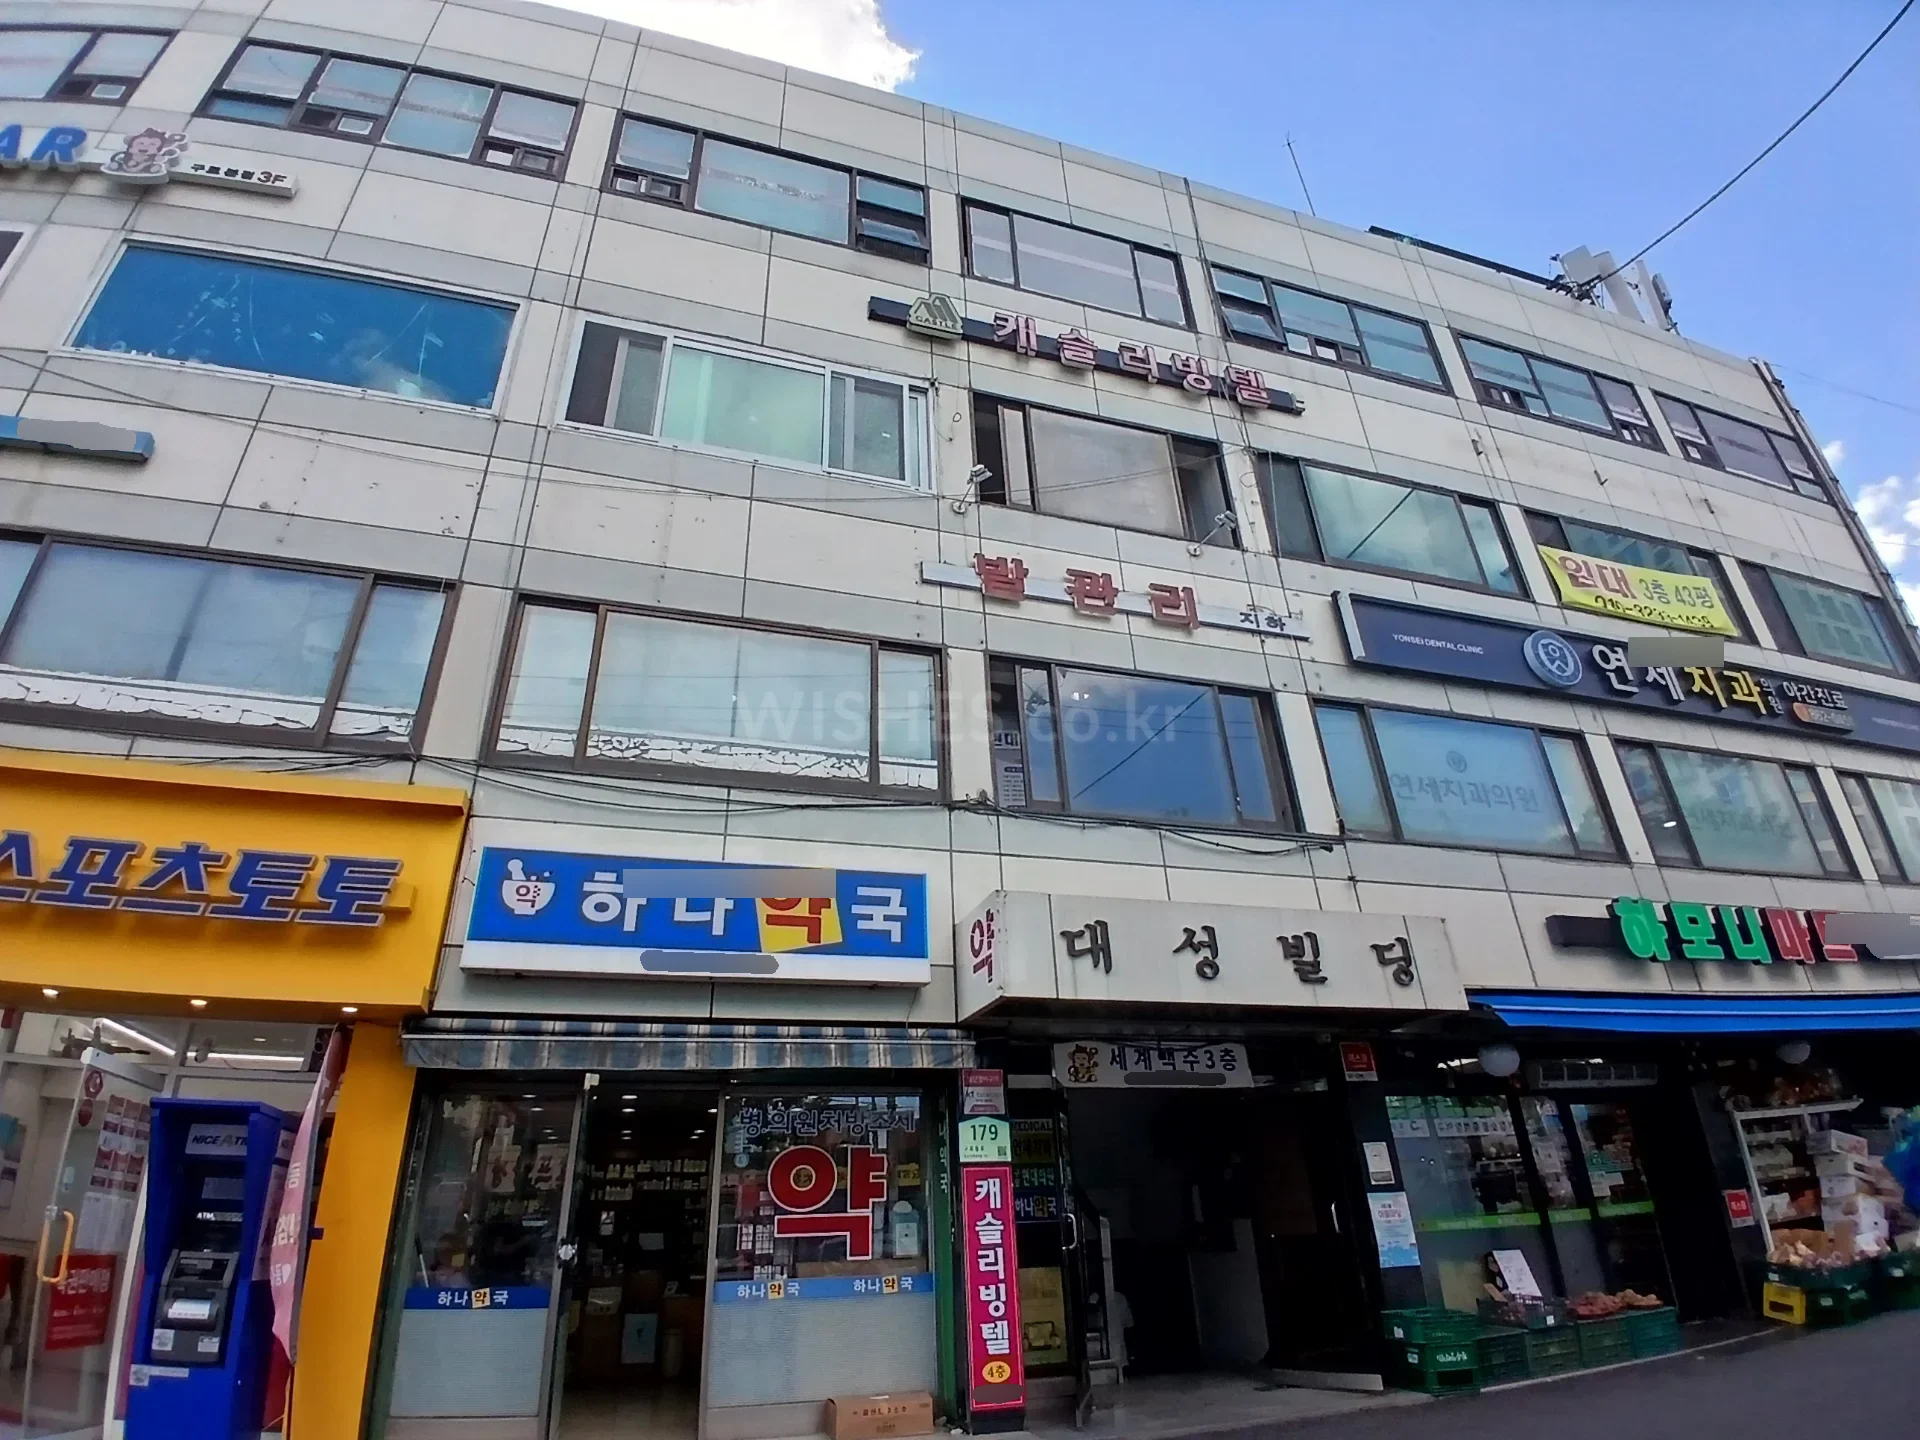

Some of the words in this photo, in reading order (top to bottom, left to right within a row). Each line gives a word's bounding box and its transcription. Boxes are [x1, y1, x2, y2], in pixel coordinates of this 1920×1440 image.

[993, 310, 1271, 409] 캐슬리빙텔
[973, 552, 1200, 630] 발관리
[1239, 611, 1286, 632] 지하
[1639, 577, 1671, 605] 3층
[1392, 633, 1424, 645] YONSEI
[1425, 638, 1456, 651] DENTAL
[1457, 643, 1484, 655] CLINIC
[1782, 680, 1848, 709] 야간진료
[1390, 773, 1541, 813] 연세치과의원
[1060, 918, 1415, 987] 대성빌딩
[191, 1135, 219, 1145] NICE
[970, 1123, 998, 1141] 179
[767, 1145, 888, 1260] 약
[974, 1177, 1011, 1356] 캐슬리빙텔
[438, 1288, 509, 1306] 하나약국
[737, 1280, 801, 1299] 하나약국
[853, 1276, 914, 1294] 하나약국
[987, 1364, 1006, 1379] 4층
